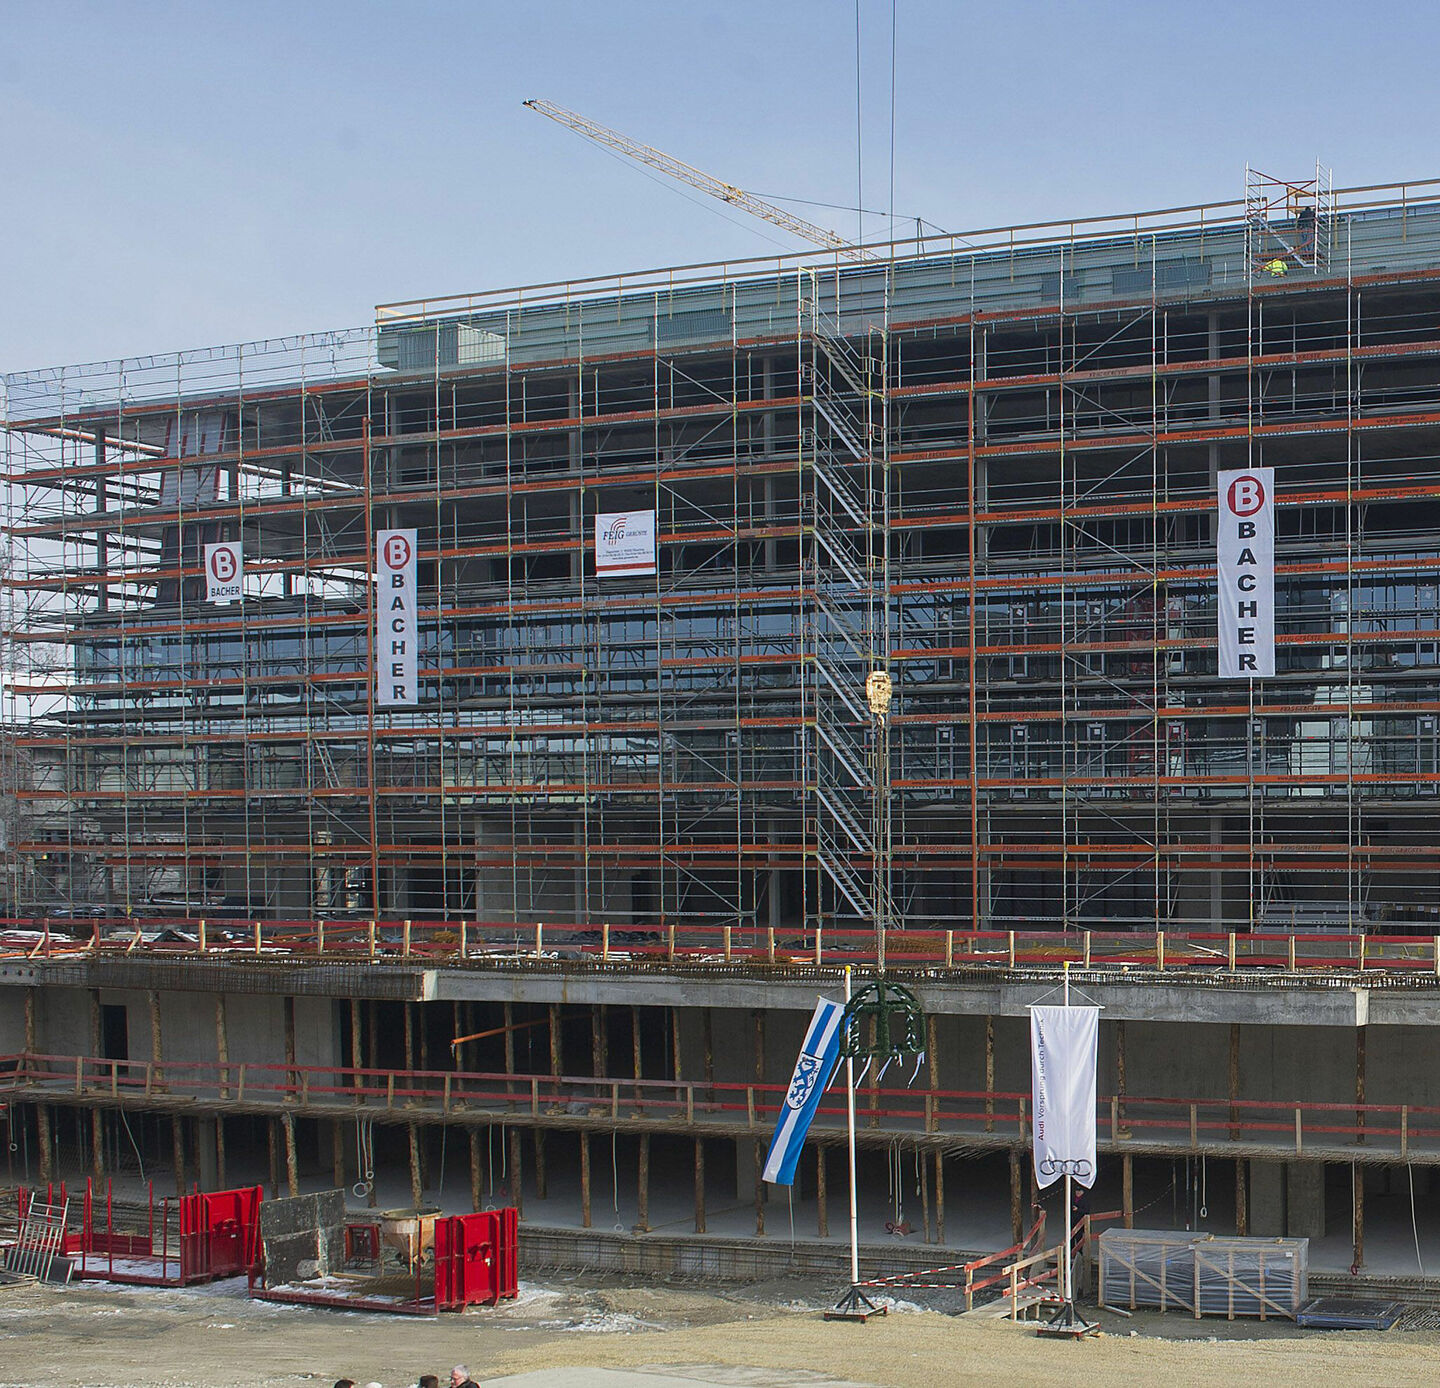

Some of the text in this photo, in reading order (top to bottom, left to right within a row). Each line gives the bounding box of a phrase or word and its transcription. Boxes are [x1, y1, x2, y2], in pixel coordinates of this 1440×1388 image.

[603, 530, 624, 540] FEIG
[211, 586, 240, 597] BACHER
[1237, 522, 1258, 671] BACHER
[390, 573, 406, 700] BACHER
